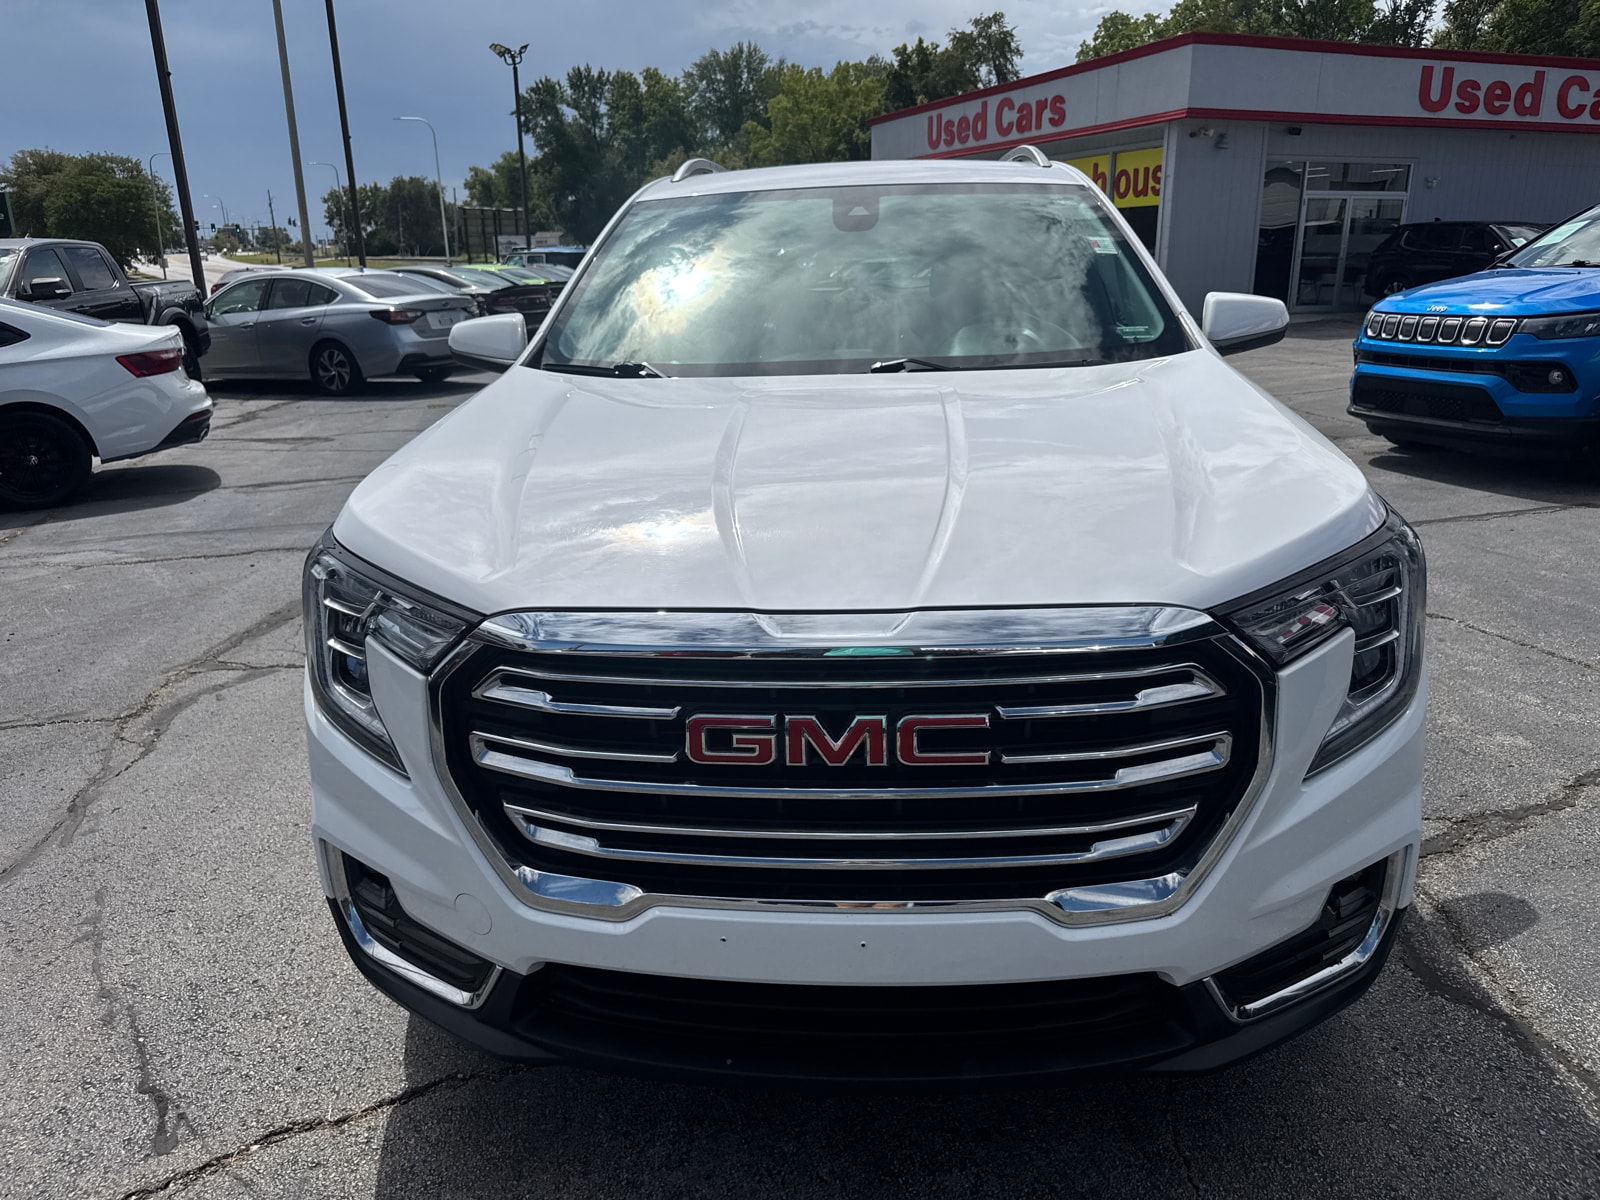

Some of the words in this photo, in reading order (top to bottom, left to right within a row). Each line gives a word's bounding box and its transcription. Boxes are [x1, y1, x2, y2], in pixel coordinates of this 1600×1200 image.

[1419, 65, 1546, 118] Used
[927, 100, 988, 150] Used
[995, 94, 1067, 137] Cars
[1426, 304, 1448, 313] Jeep
[685, 713, 991, 766] GMC
